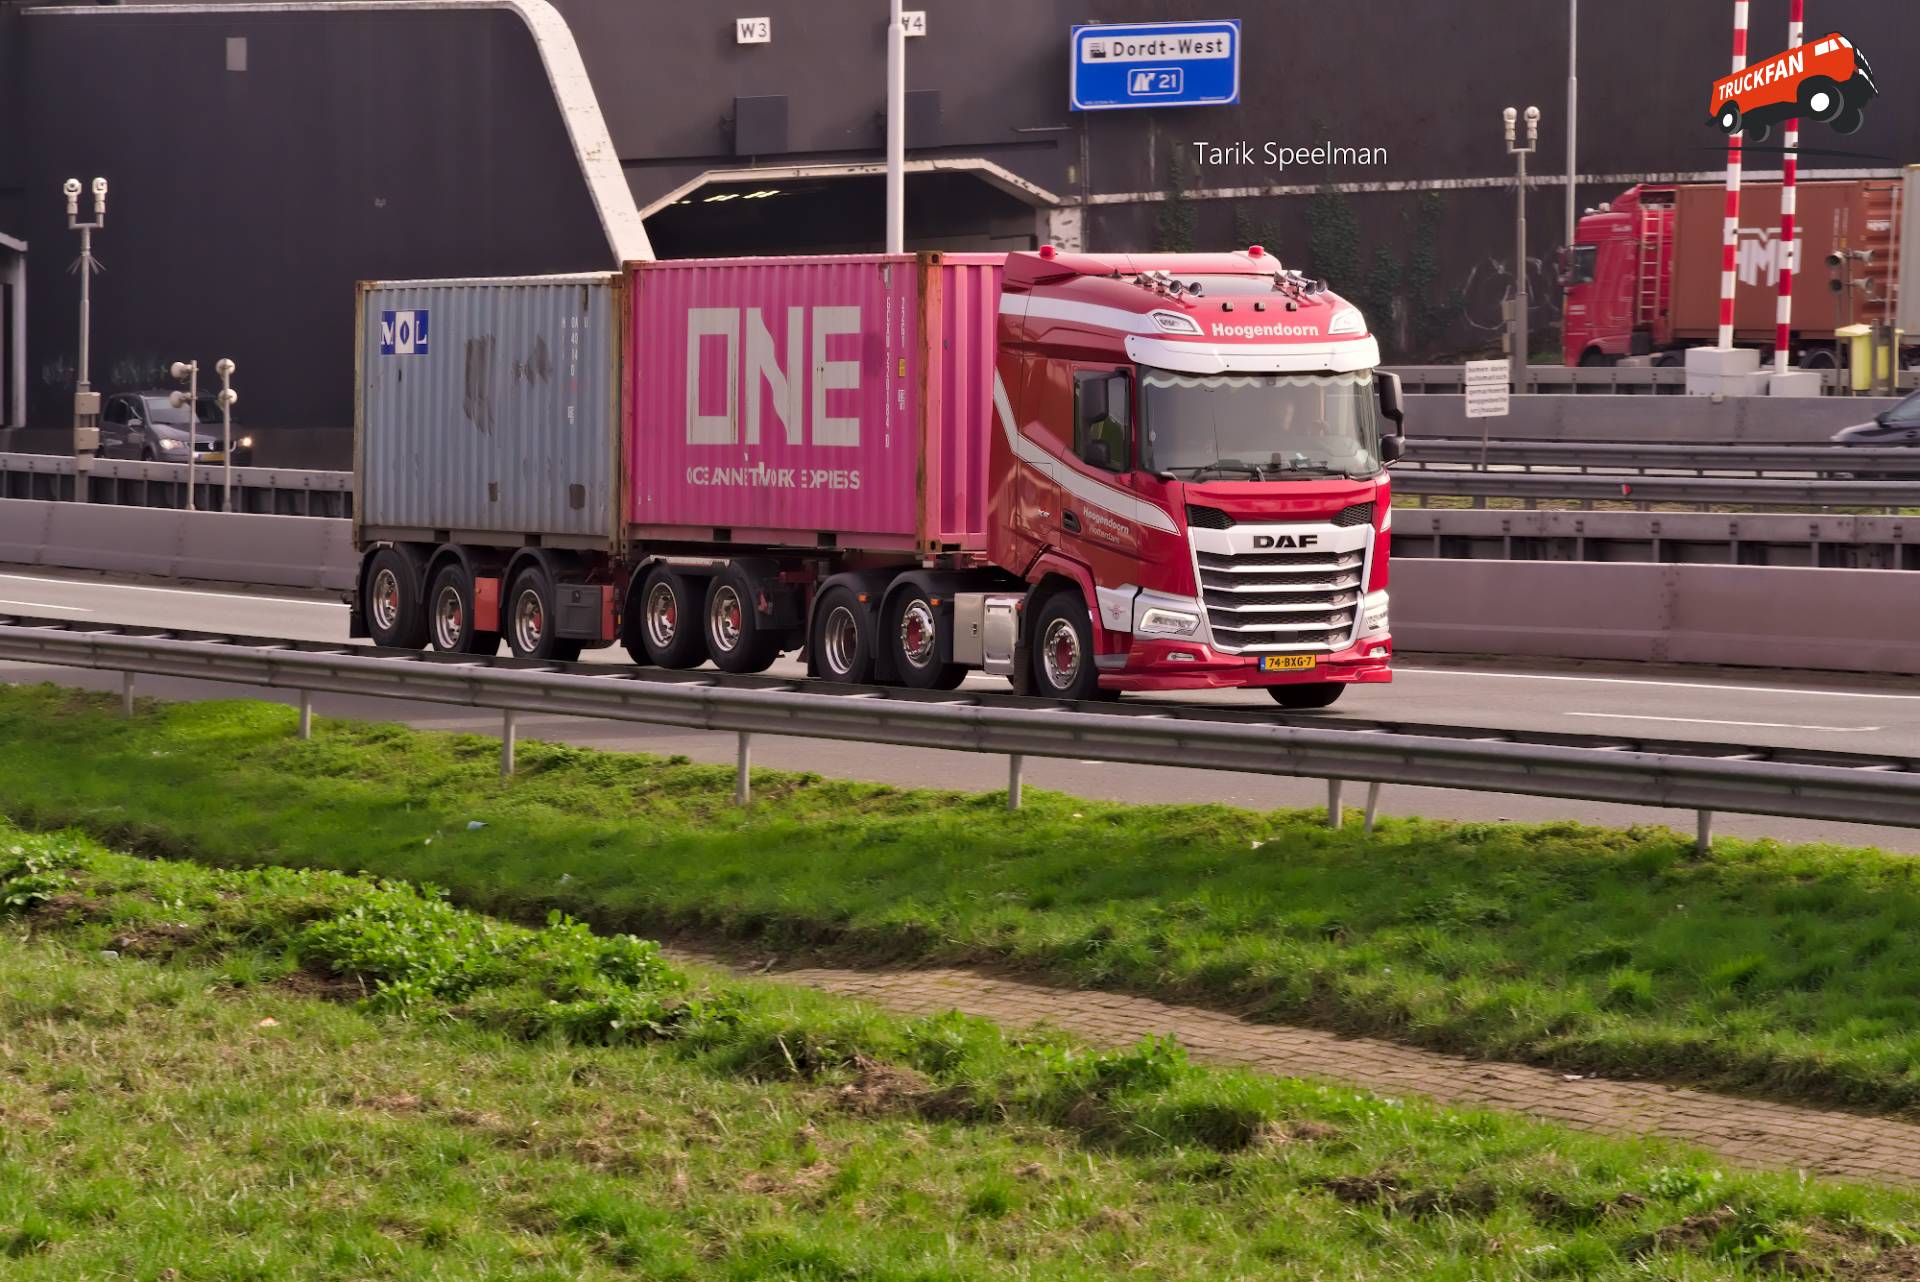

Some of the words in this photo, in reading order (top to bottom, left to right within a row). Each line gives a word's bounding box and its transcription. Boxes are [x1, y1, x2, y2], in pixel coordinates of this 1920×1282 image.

[740, 22, 768, 38] W3
[1112, 37, 1224, 57] Dordt-West
[1158, 73, 1177, 89] 21
[380, 319, 428, 346] MOL
[1211, 322, 1320, 339] Hoogendoorn
[686, 305, 862, 447] ONE
[1083, 505, 1129, 535] Hoogendoorn
[1253, 535, 1318, 549] DAF
[1269, 656, 1312, 668] 74-BXG-7
